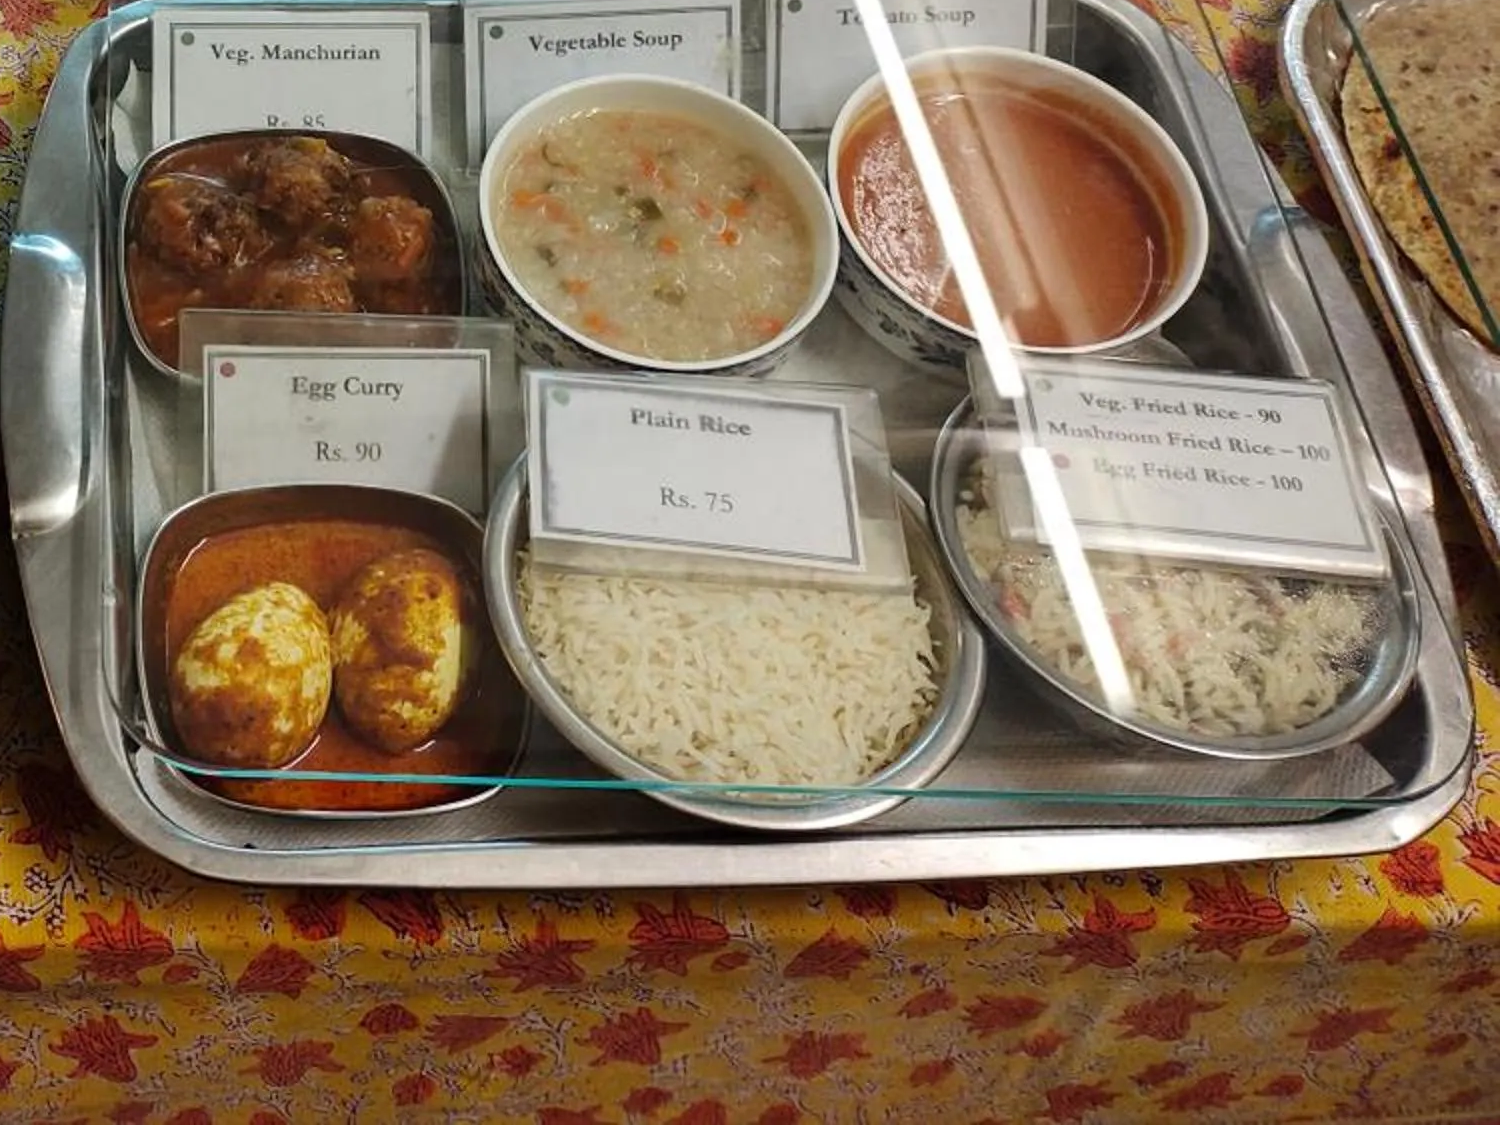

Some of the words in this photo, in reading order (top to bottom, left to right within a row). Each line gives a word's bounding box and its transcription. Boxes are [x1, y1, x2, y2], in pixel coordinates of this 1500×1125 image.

[837, 8, 918, 26] Toato
[924, 6, 976, 27] Soup
[211, 43, 255, 66] Veg.
[261, 43, 381, 61] Manchurian
[529, 33, 626, 56] Vegetable
[633, 30, 684, 51] Soup
[291, 376, 338, 401] Egg
[343, 376, 405, 401] Curry
[629, 407, 692, 431] Plain
[699, 412, 752, 437] Rice
[1079, 392, 1127, 414] Veg.
[1134, 397, 1189, 417] Fried
[1195, 401, 1240, 422] Rice
[1257, 406, 1283, 425] 90
[315, 441, 348, 463] Rs.
[355, 441, 382, 462] 90
[1046, 419, 1162, 447] Mushroom
[1167, 431, 1222, 453] Fried
[1228, 437, 1275, 458] Rice
[1299, 444, 1331, 463] 100
[1092, 456, 1137, 481] Egg
[1142, 461, 1198, 483] Fried
[1204, 467, 1252, 489] Rice
[1270, 474, 1304, 494] 100
[659, 486, 697, 511] Rs.
[703, 491, 735, 515] 75
